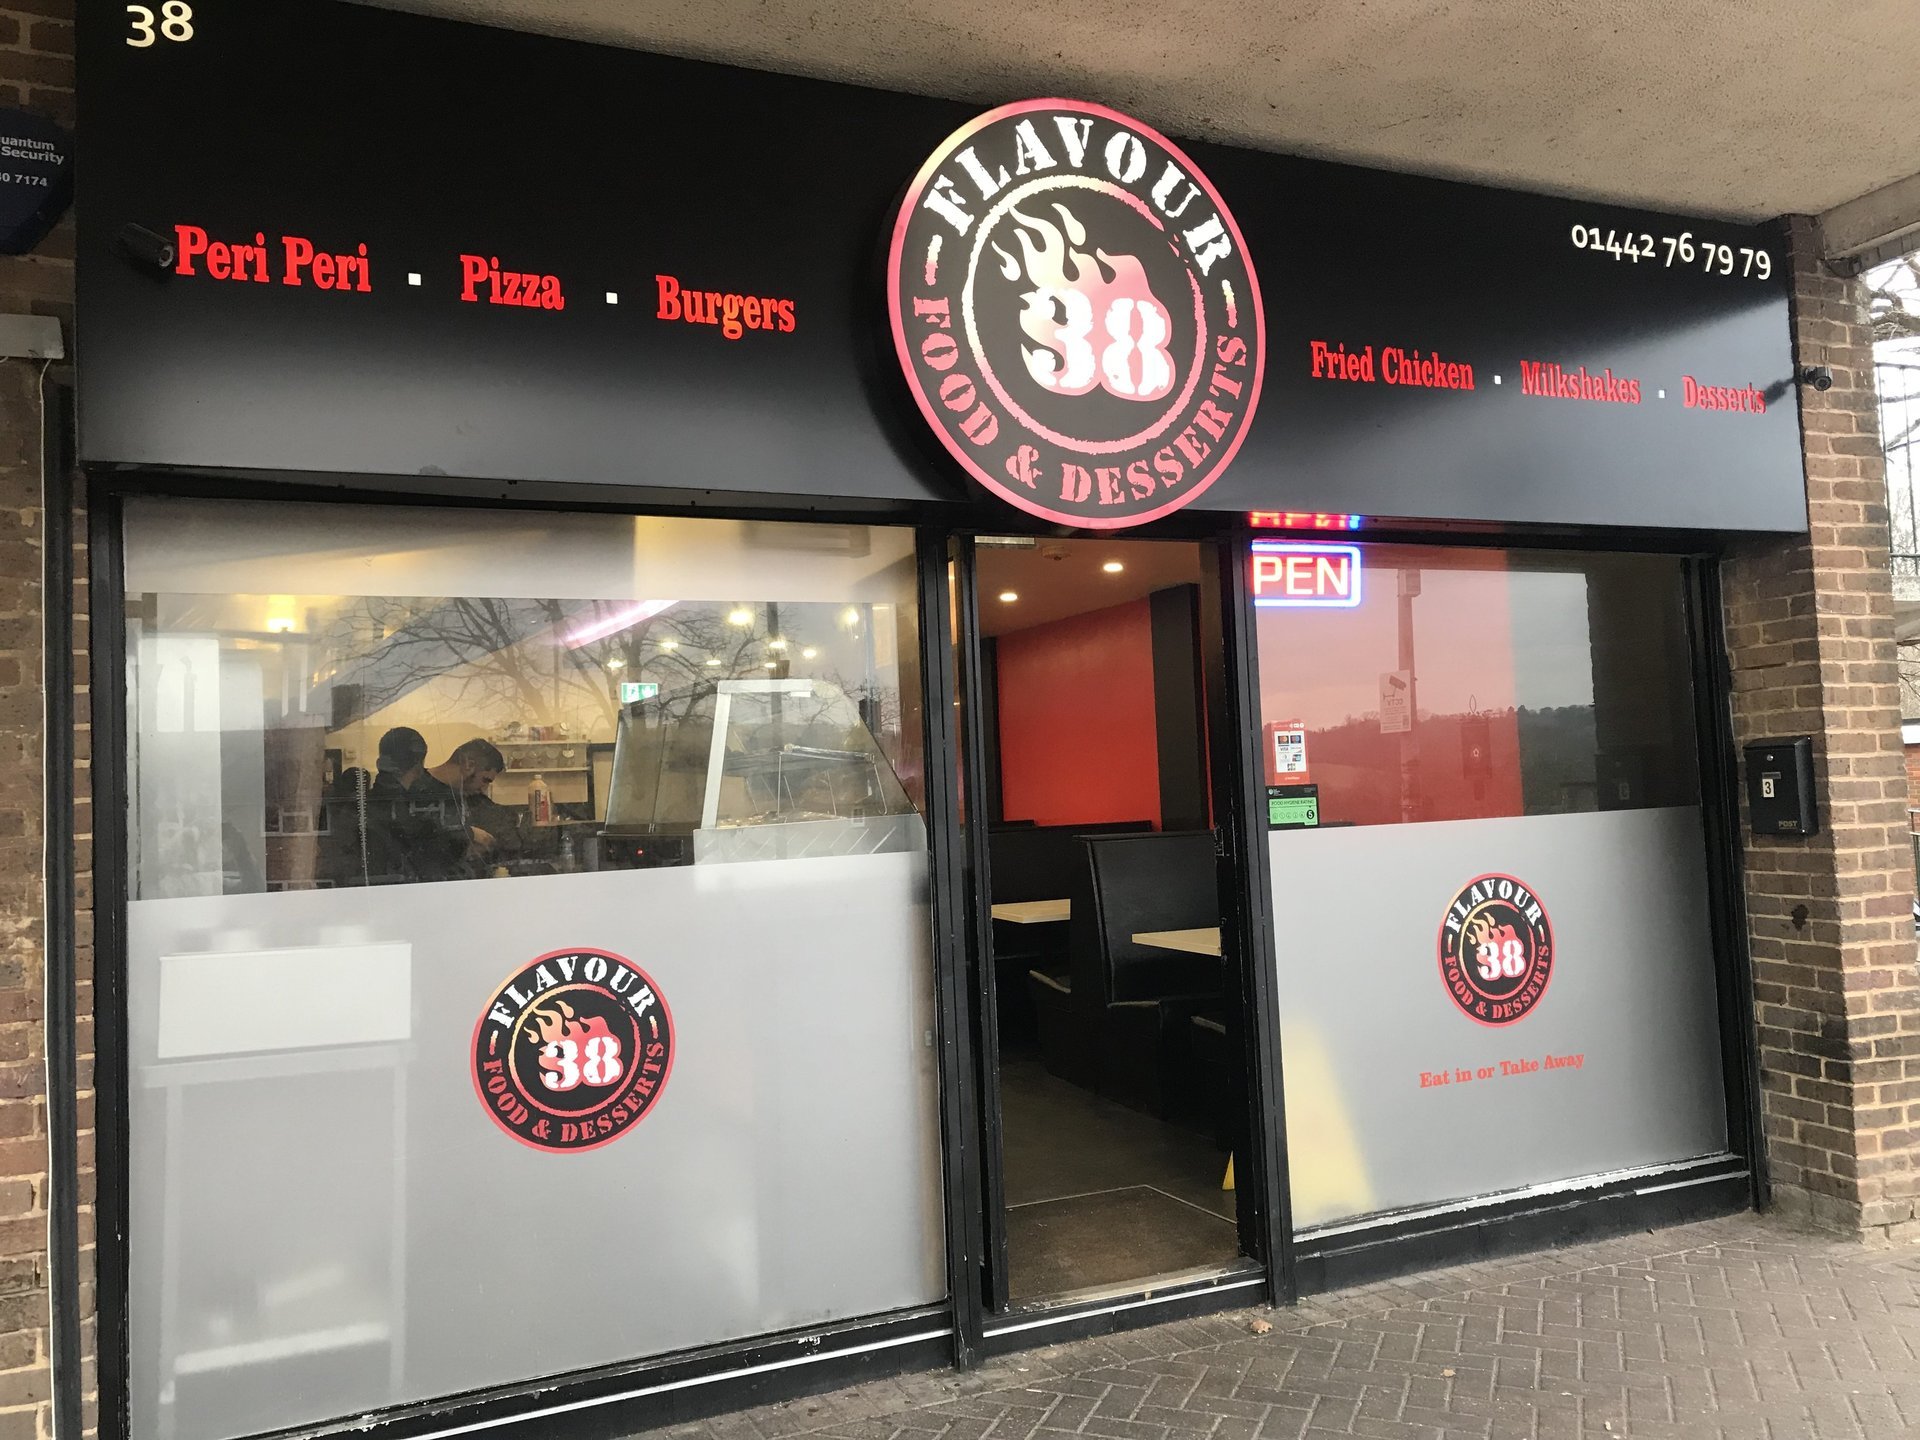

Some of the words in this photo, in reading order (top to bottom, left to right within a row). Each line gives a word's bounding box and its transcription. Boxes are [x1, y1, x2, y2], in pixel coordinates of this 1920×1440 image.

[126, 0, 194, 47] 38
[0, 136, 55, 151] uantum
[1, 146, 64, 165] Security
[15, 174, 47, 187] 7174
[923, 116, 1232, 276] FLAVOUR
[174, 224, 270, 283] Peri
[282, 236, 372, 292] Peri
[1571, 224, 1656, 264] 01442
[1662, 232, 1695, 268] 76
[1701, 242, 1734, 276] 79
[1740, 248, 1772, 280] 79
[460, 254, 565, 311] Pizza
[655, 274, 796, 340] Burgers
[1019, 286, 1174, 400] 38
[1310, 340, 1376, 382] Fried
[1381, 346, 1475, 390] Chicken
[913, 296, 999, 446] FOOD
[1005, 444, 1042, 490] &
[1059, 335, 1247, 505] DESSERTS
[1520, 360, 1641, 404] Milkshakes
[1682, 374, 1767, 414] Desserts
[1765, 781, 1771, 794] 3
[1307, 810, 1314, 819] 5
[1445, 879, 1542, 934] FLAVOUR
[1445, 956, 1474, 1006] FOOD
[1476, 1001, 1487, 1017] &
[1492, 944, 1549, 1019] DESSERTS
[1475, 939, 1525, 980] 38
[488, 956, 656, 1028] FLAVOUR
[539, 1036, 621, 1089] 38
[1419, 1072, 1450, 1088] Eat
[1455, 1067, 1472, 1083] in
[1477, 1063, 1495, 1080] or
[1500, 1057, 1539, 1076] Take
[1544, 1054, 1585, 1070] Away
[483, 1059, 529, 1125] FOOD
[532, 1119, 552, 1140] &
[560, 1042, 664, 1142] DESSERTS
